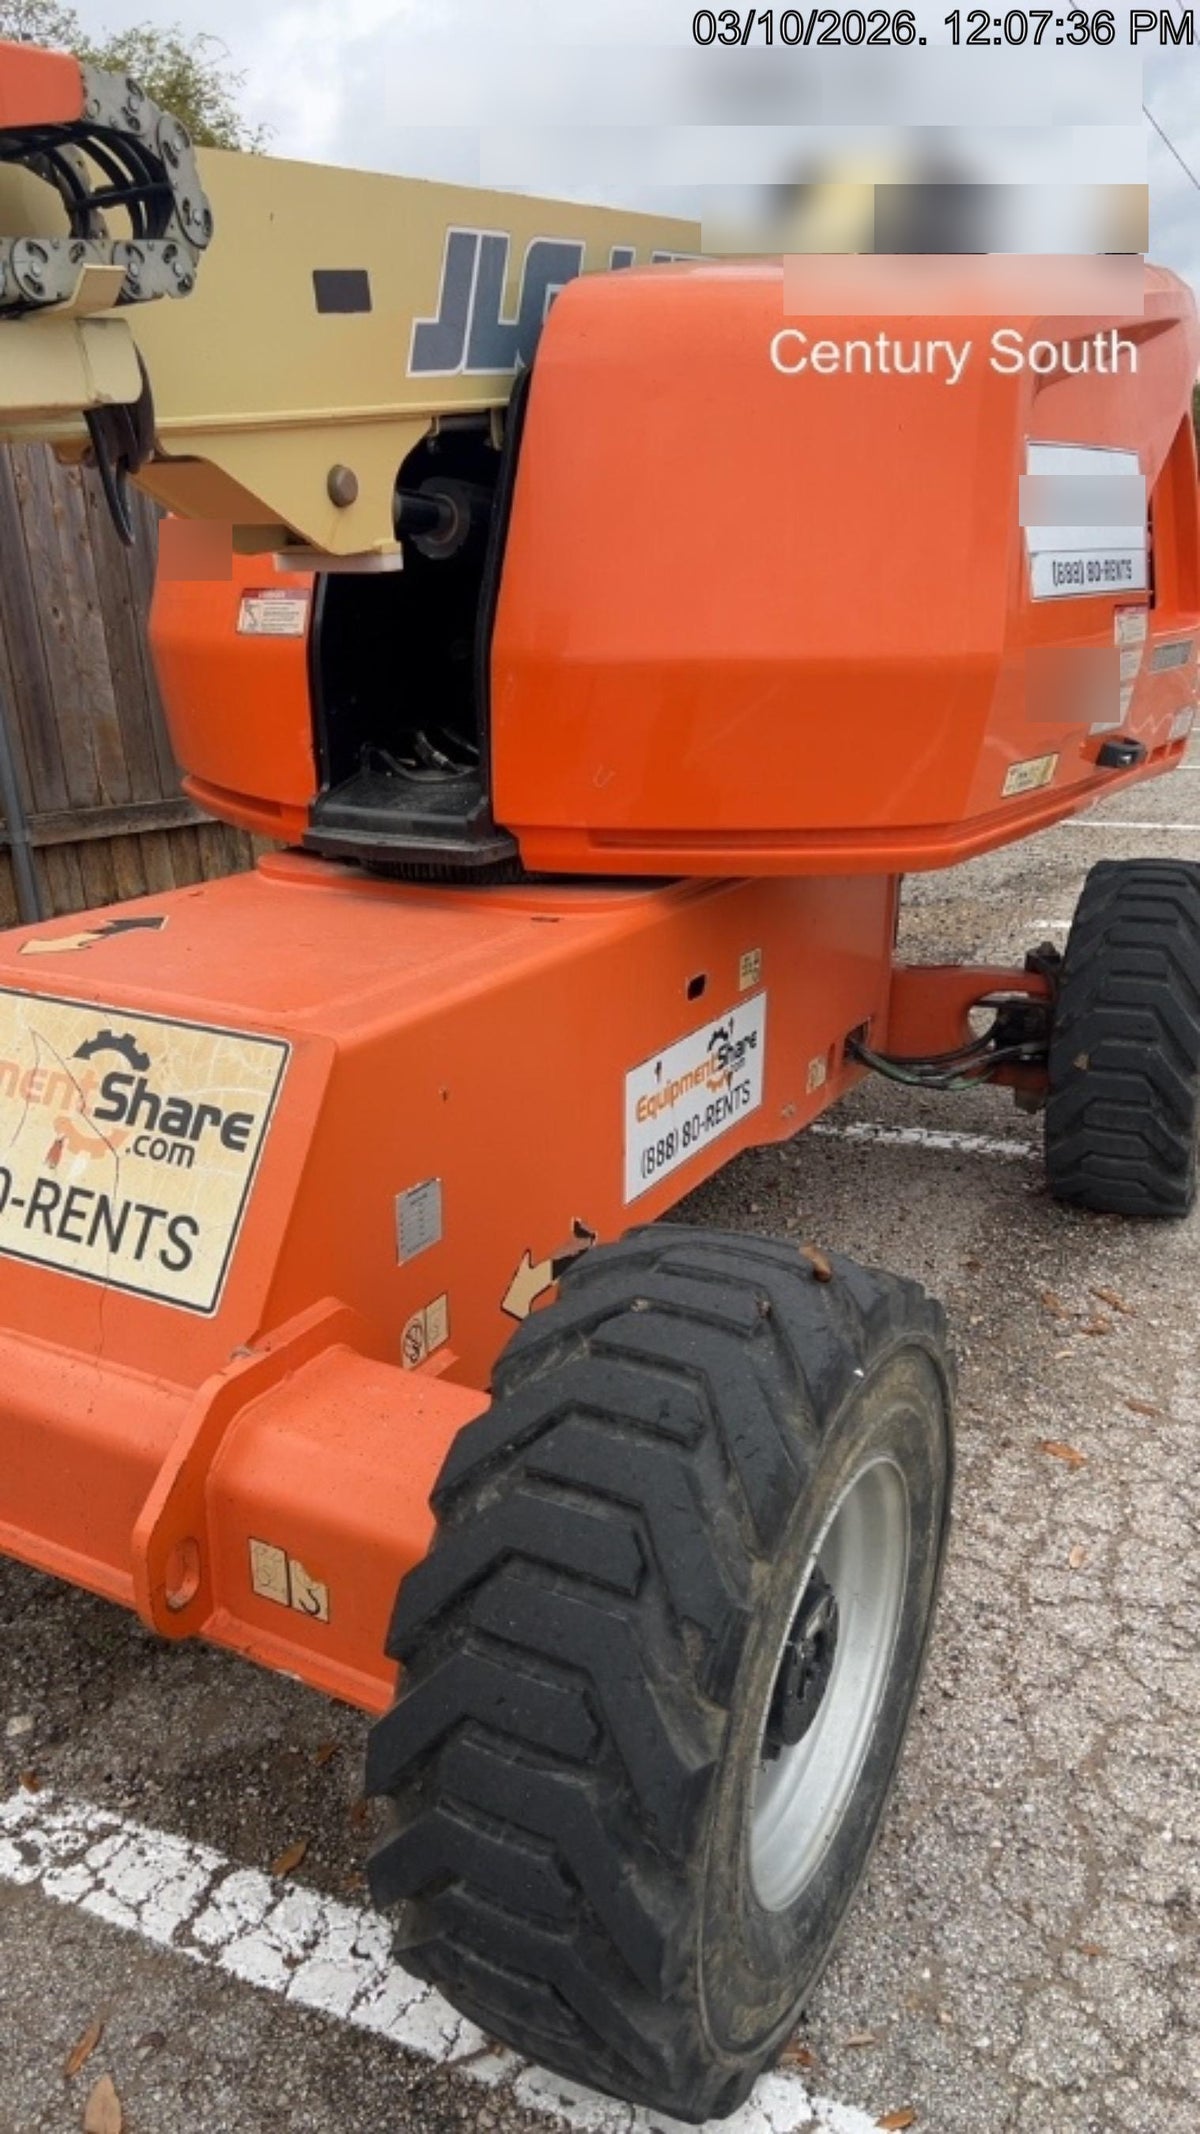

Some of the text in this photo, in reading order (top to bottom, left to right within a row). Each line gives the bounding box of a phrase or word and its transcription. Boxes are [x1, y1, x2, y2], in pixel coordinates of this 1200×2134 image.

[125, 1134, 196, 1169] .com
[641, 1079, 750, 1179] (888) 80-RENTS
